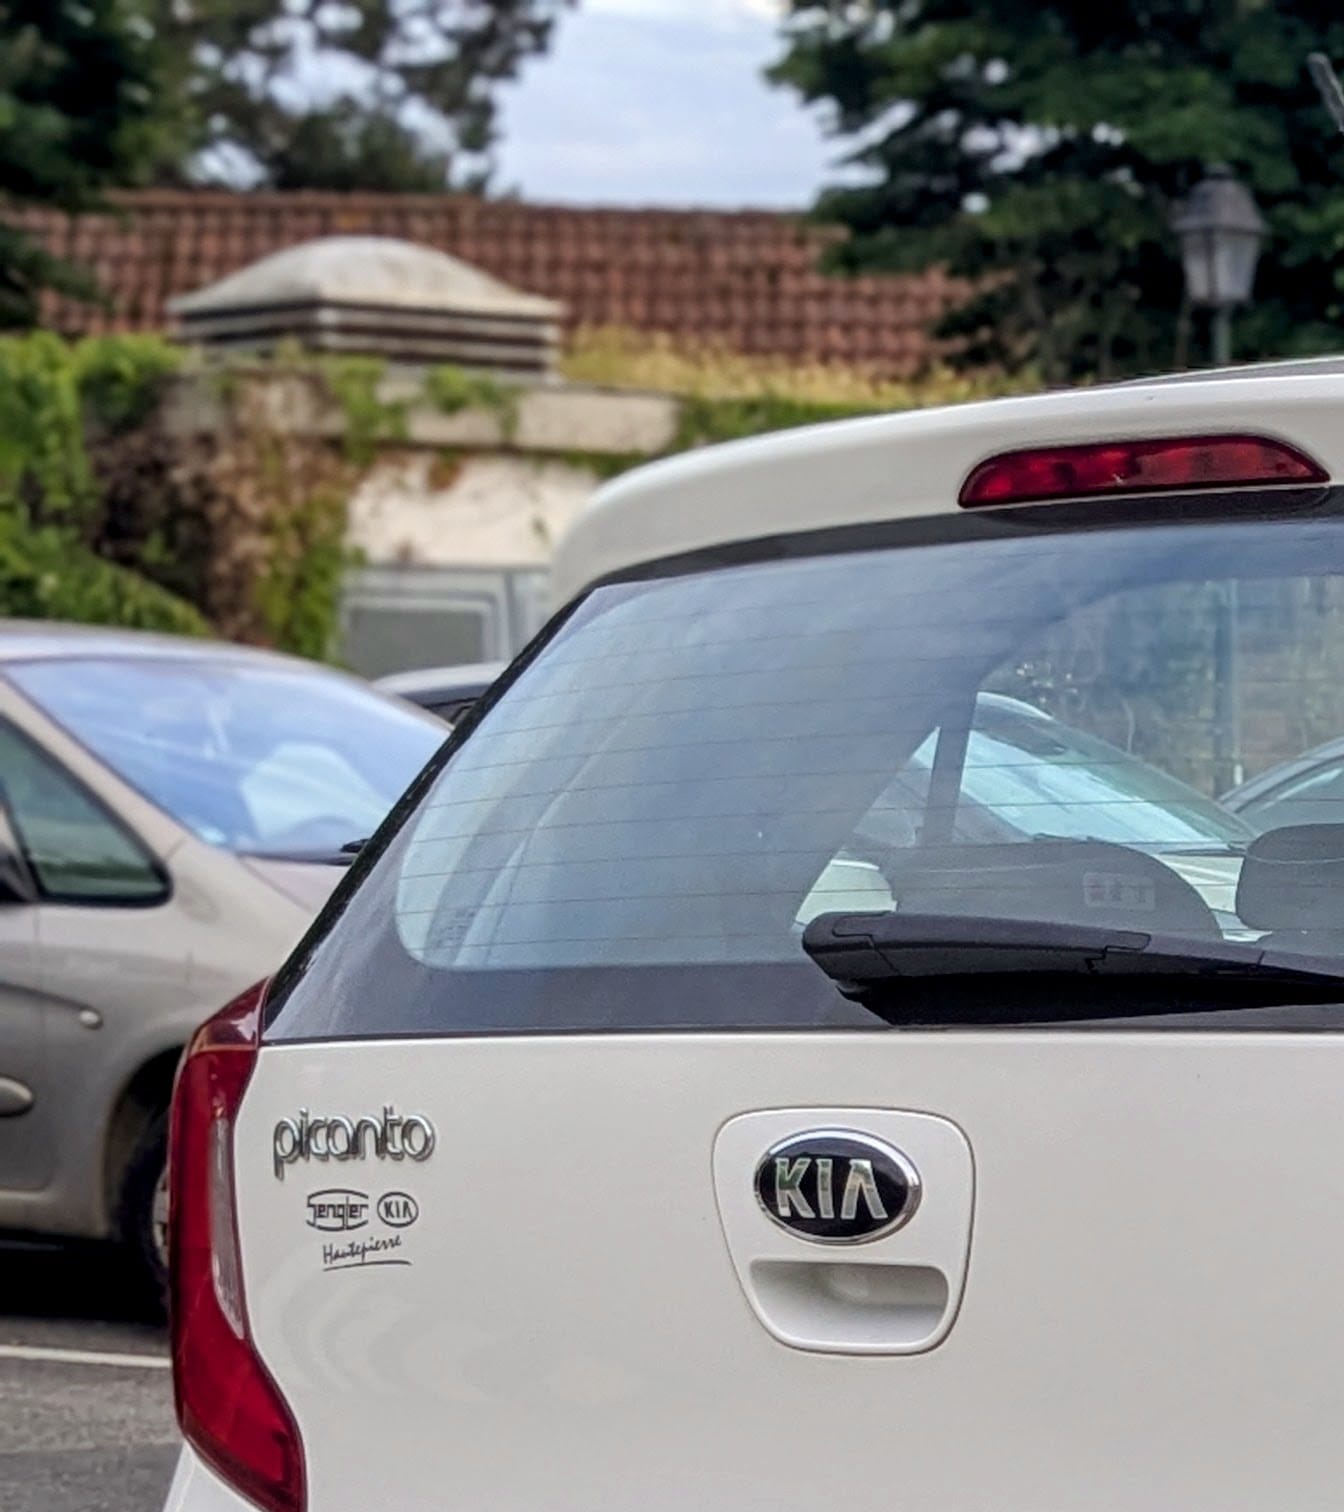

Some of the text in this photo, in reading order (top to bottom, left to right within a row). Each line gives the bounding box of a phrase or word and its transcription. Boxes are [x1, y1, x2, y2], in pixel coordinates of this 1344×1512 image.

[273, 1106, 435, 1181] picanto
[384, 1200, 413, 1219] KIA
[775, 1157, 888, 1219] KIA
